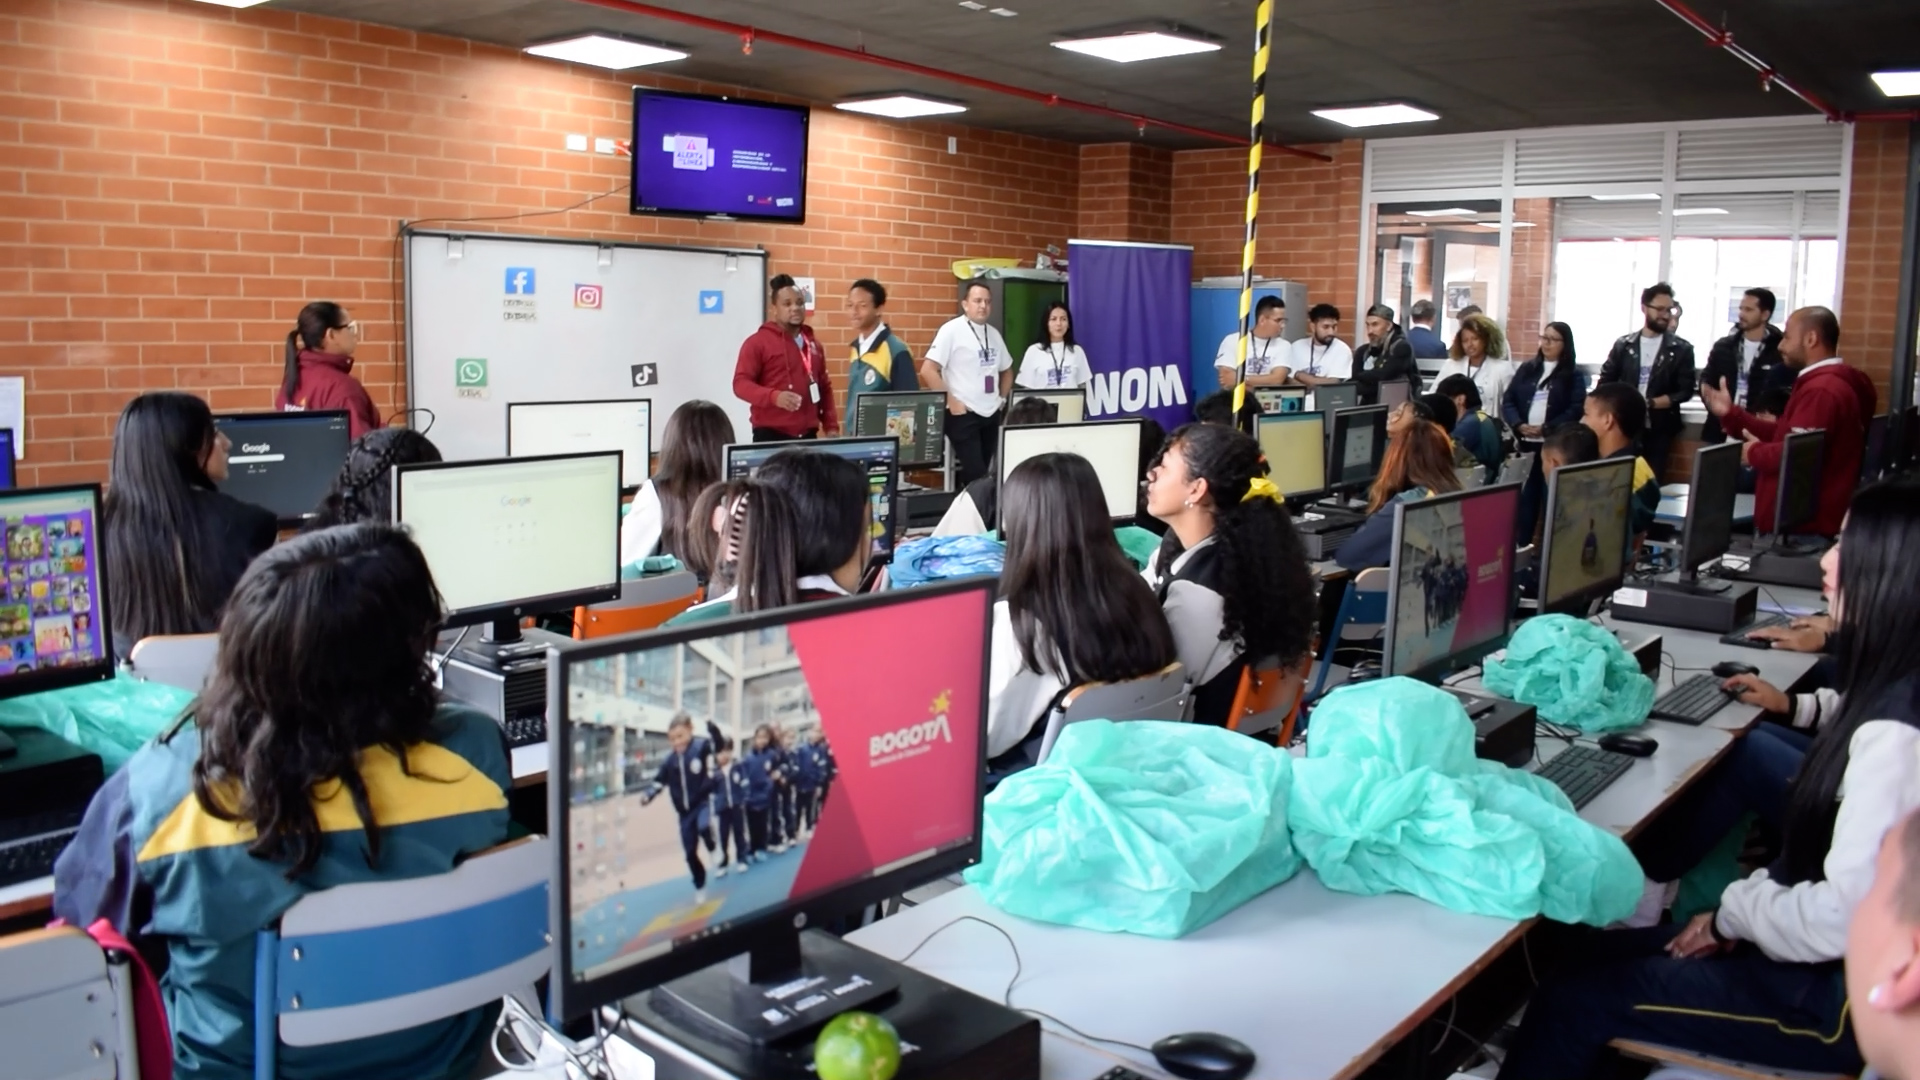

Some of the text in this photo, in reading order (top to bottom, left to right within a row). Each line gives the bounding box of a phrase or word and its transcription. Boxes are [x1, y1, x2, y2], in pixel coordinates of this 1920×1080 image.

[1085, 364, 1187, 416] WOM
[241, 442, 271, 454] Google
[500, 494, 532, 507] Google
